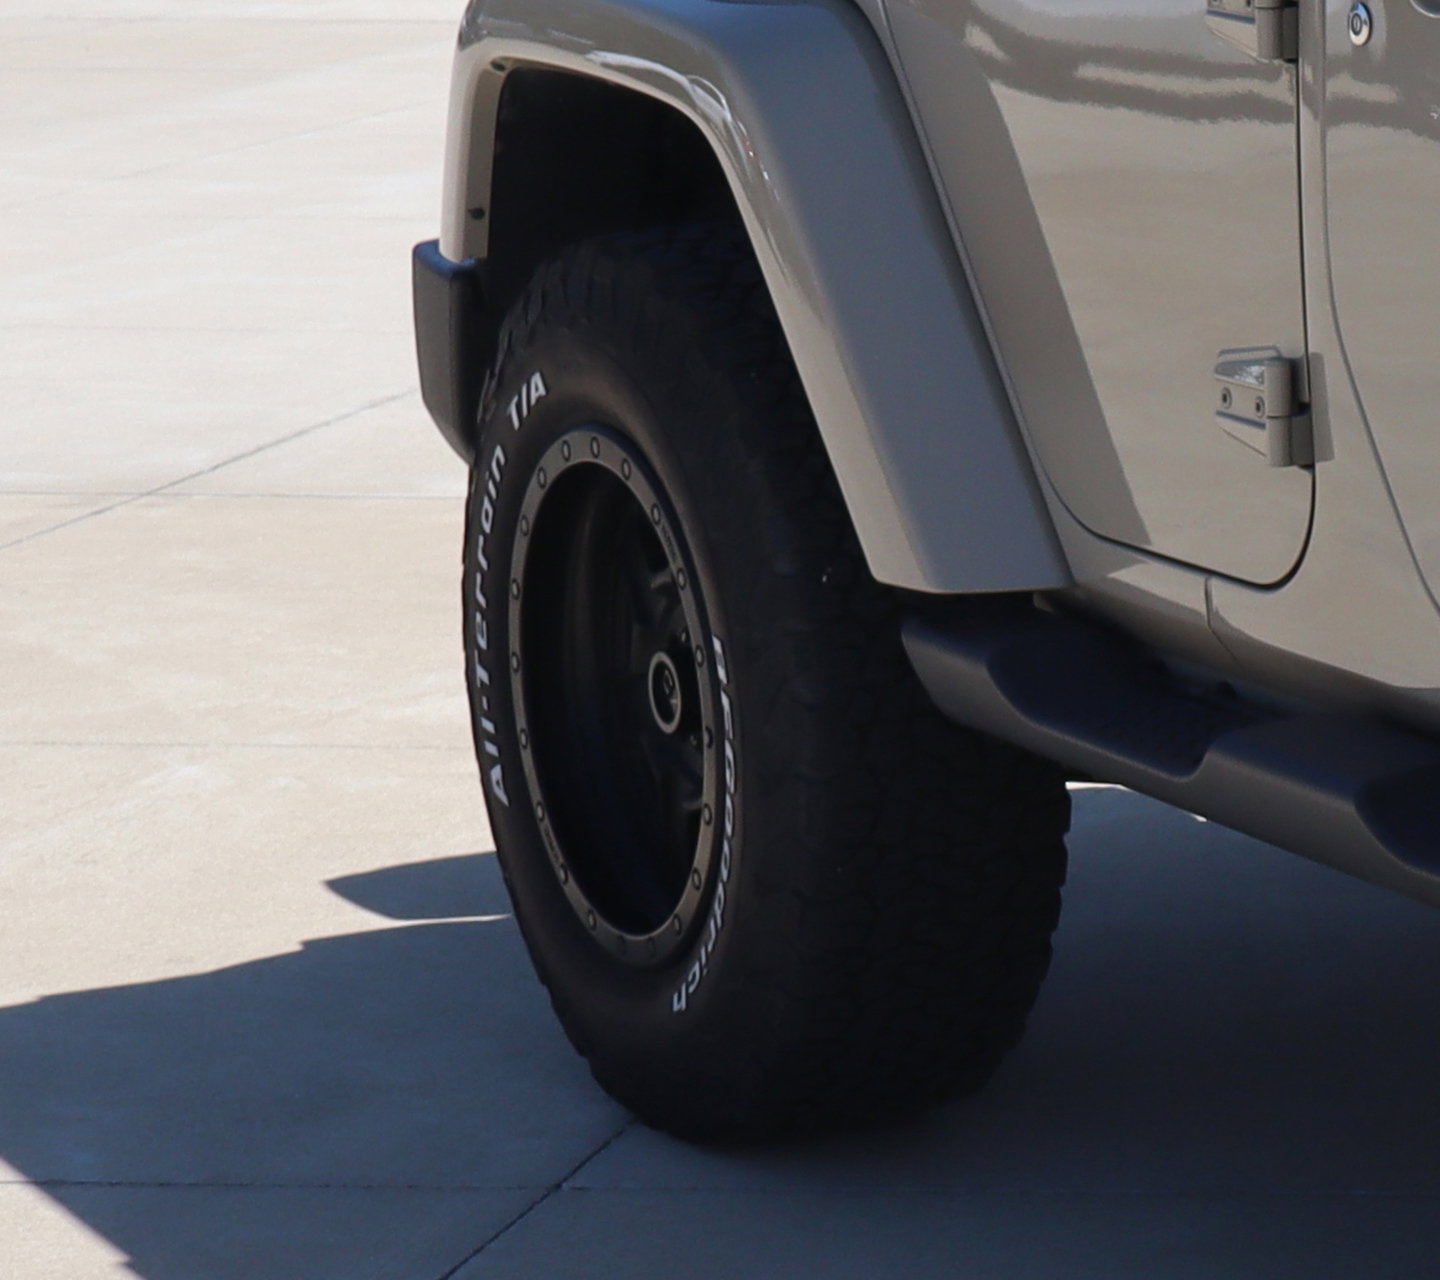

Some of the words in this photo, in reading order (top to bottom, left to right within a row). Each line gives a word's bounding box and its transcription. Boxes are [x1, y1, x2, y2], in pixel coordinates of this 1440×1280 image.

[506, 370, 550, 431] T/A
[470, 446, 509, 808] All-Terrain
[670, 632, 741, 1014] BFGoodrich
